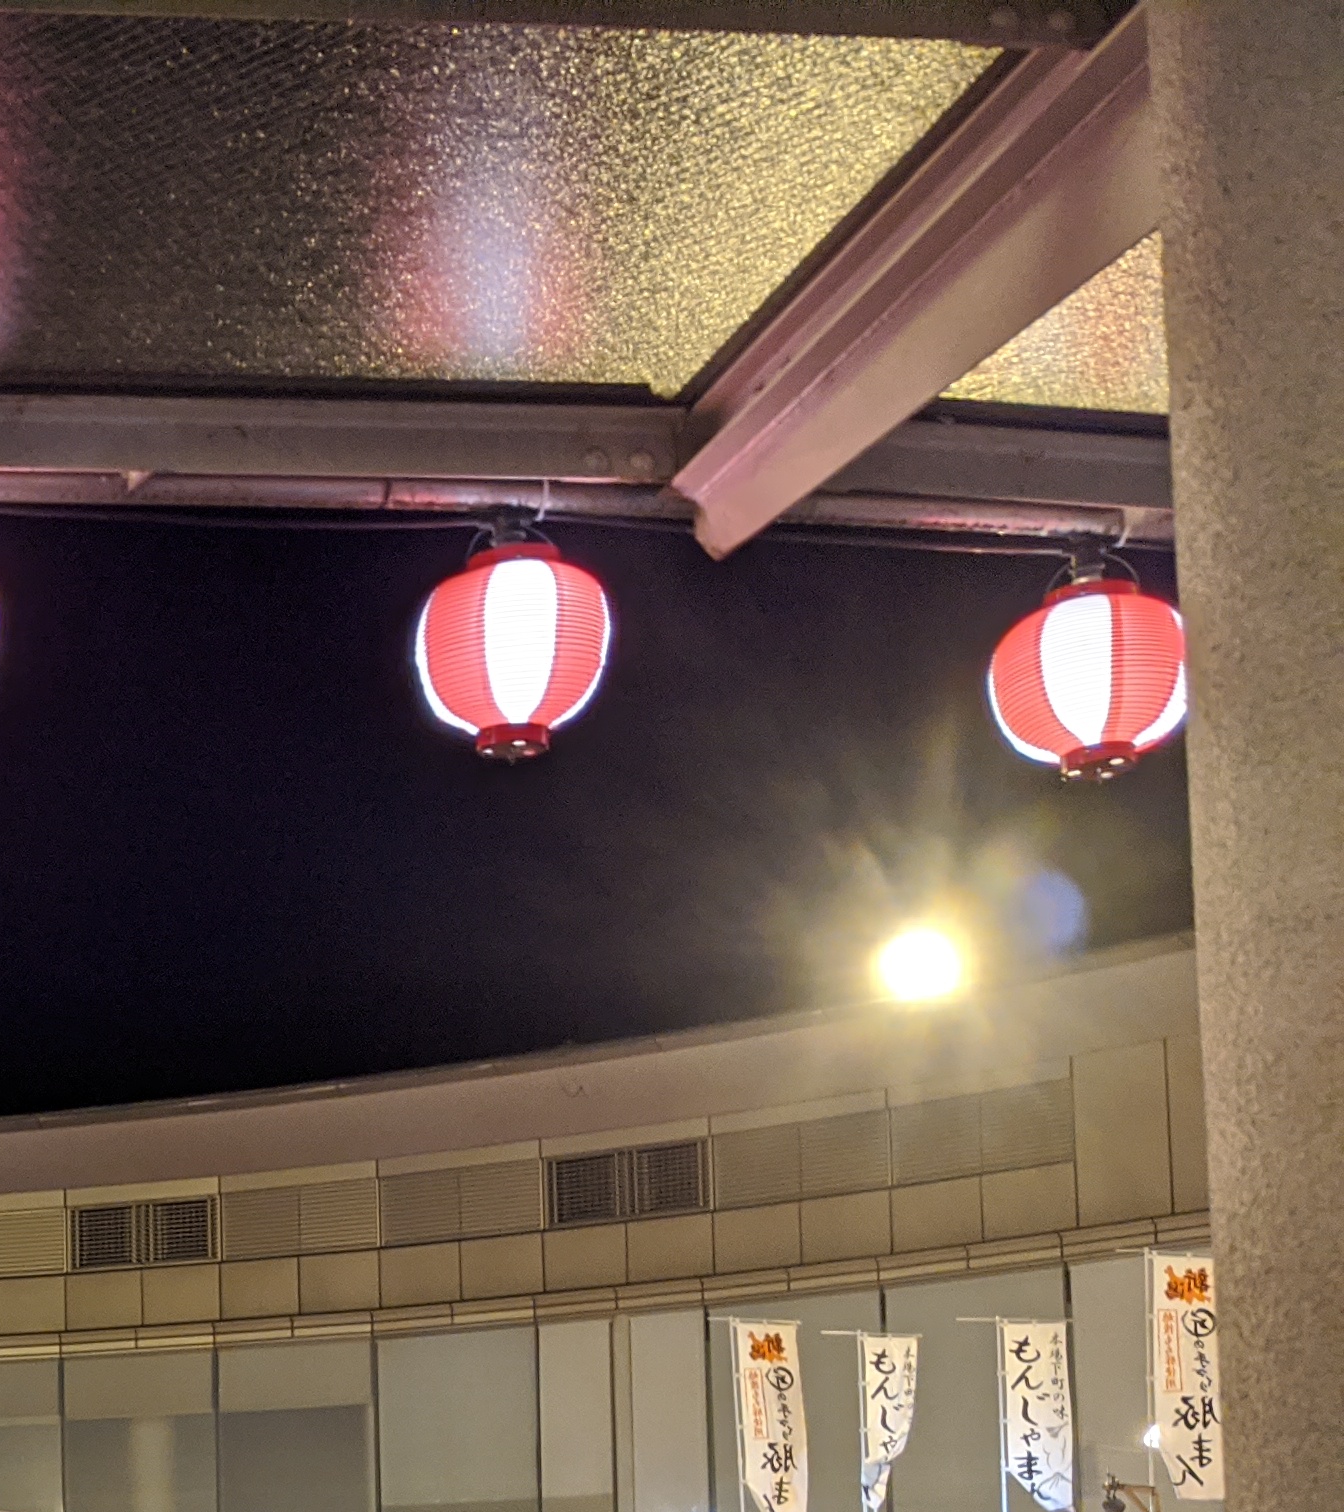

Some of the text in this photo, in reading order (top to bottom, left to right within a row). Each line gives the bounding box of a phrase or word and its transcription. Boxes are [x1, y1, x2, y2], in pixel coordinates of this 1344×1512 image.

[1009, 1334, 1052, 1501] もんじゃまん
[1048, 1331, 1068, 1420] 本場下町の味
